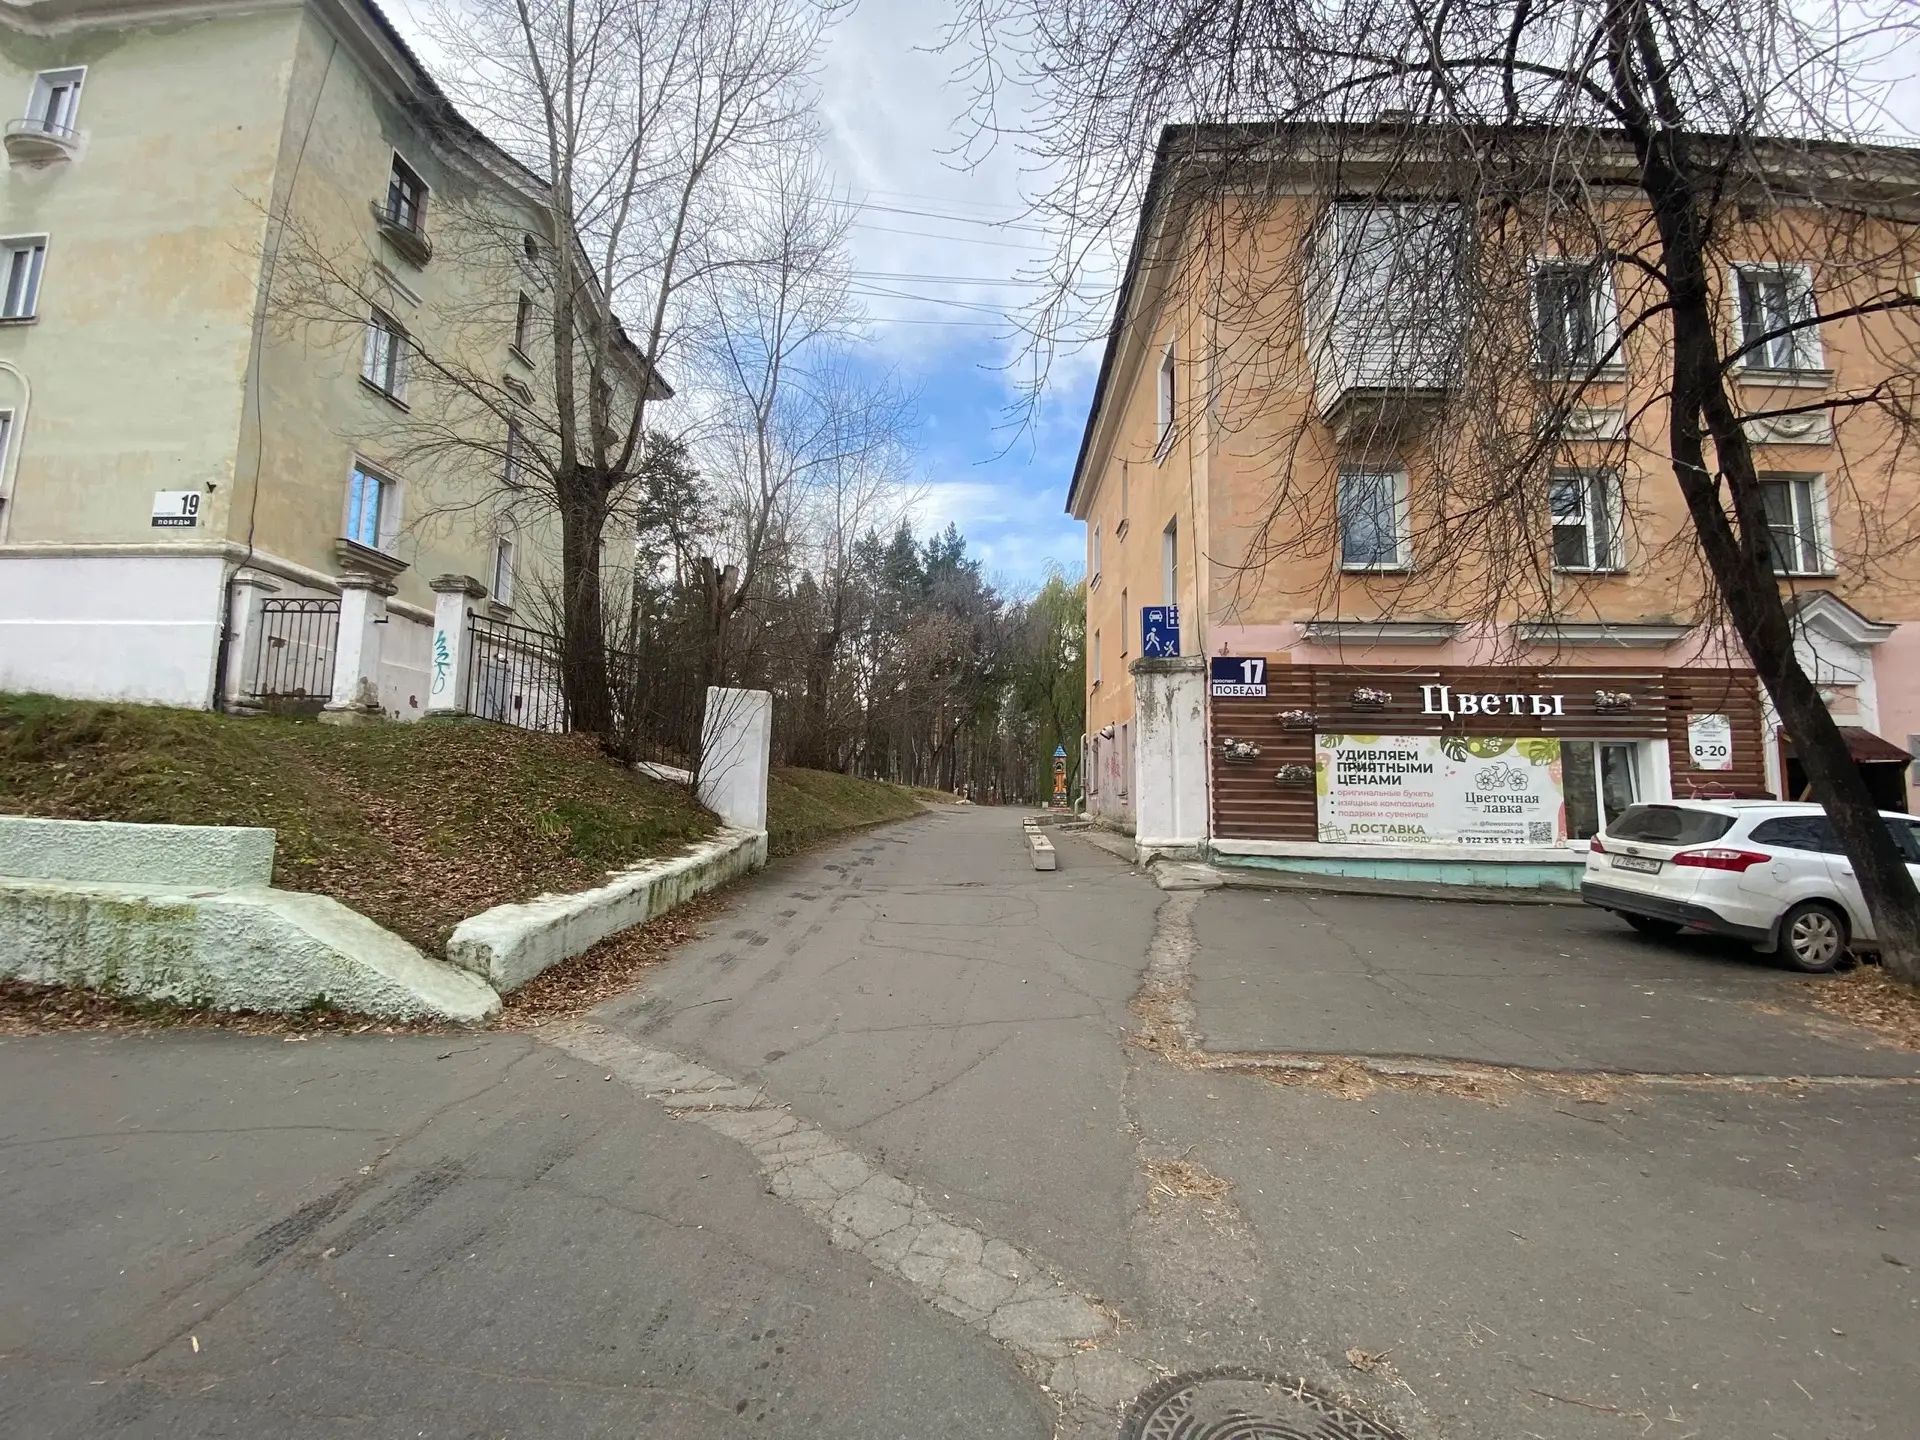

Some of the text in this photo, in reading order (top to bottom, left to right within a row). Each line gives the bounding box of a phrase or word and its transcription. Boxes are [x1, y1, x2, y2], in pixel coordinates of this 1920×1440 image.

[181, 494, 200, 515] 19
[1240, 659, 1264, 684] 17
[1215, 685, 1264, 696] ПОБЕДЫ
[1419, 684, 1565, 721] Цветы
[1336, 750, 1419, 761] УДИВЛЯЕМ
[1694, 745, 1727, 756] 8-20
[1336, 762, 1434, 774] ПРИЯТНЫМИ
[1337, 775, 1402, 786] ЦЕНАМИ
[1337, 789, 1434, 798] оригинальные букеты
[1465, 792, 1539, 804] Цветочная
[1380, 801, 1435, 809] композиции
[1482, 805, 1522, 813] лавка
[1338, 810, 1376, 818] подарки
[1385, 811, 1429, 819] сувениры
[1349, 824, 1426, 835] ДОСТАВКА
[1396, 835, 1433, 843] ГОРОДУ
